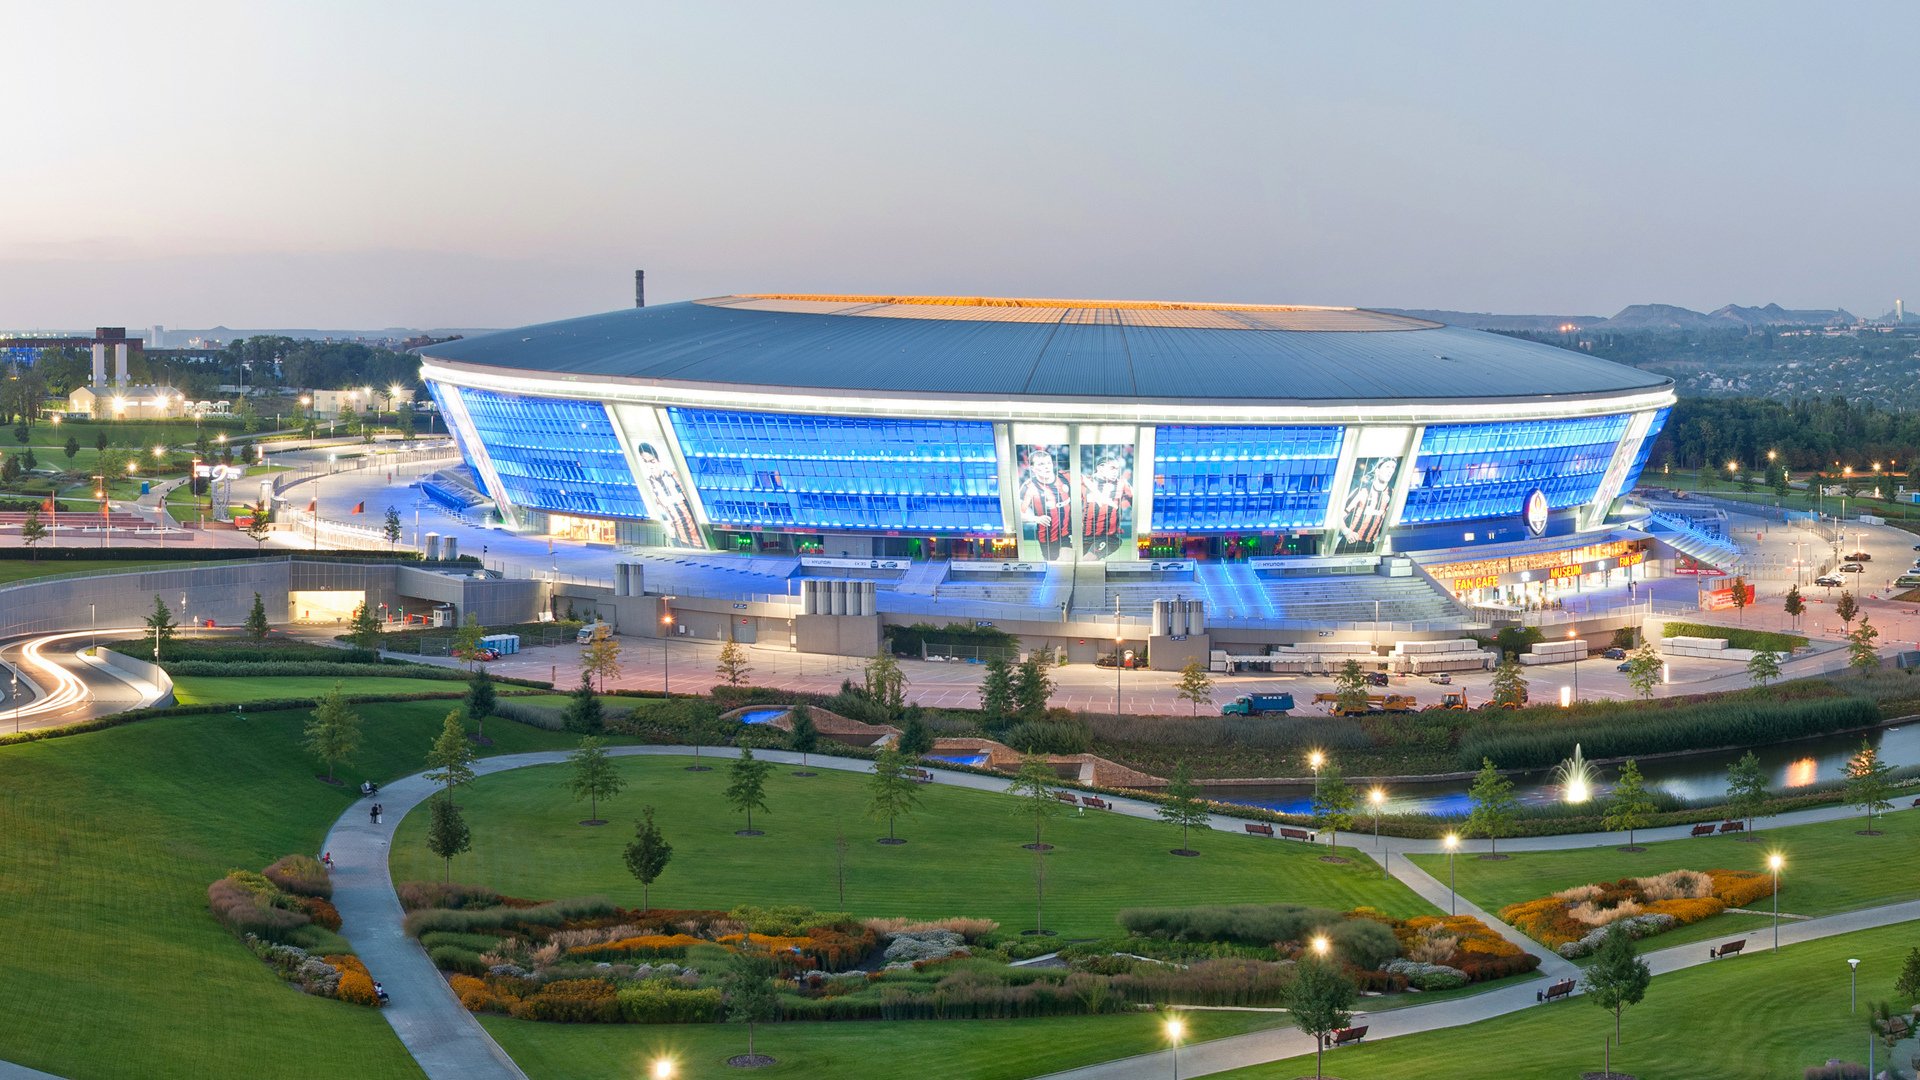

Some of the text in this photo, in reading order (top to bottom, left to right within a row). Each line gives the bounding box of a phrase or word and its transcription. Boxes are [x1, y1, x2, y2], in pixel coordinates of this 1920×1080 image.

[1098, 541, 1106, 550] 9
[1619, 556, 1630, 567] FAN
[1550, 564, 1582, 579] MUSEUM
[1455, 575, 1499, 591] FAN CAFE
